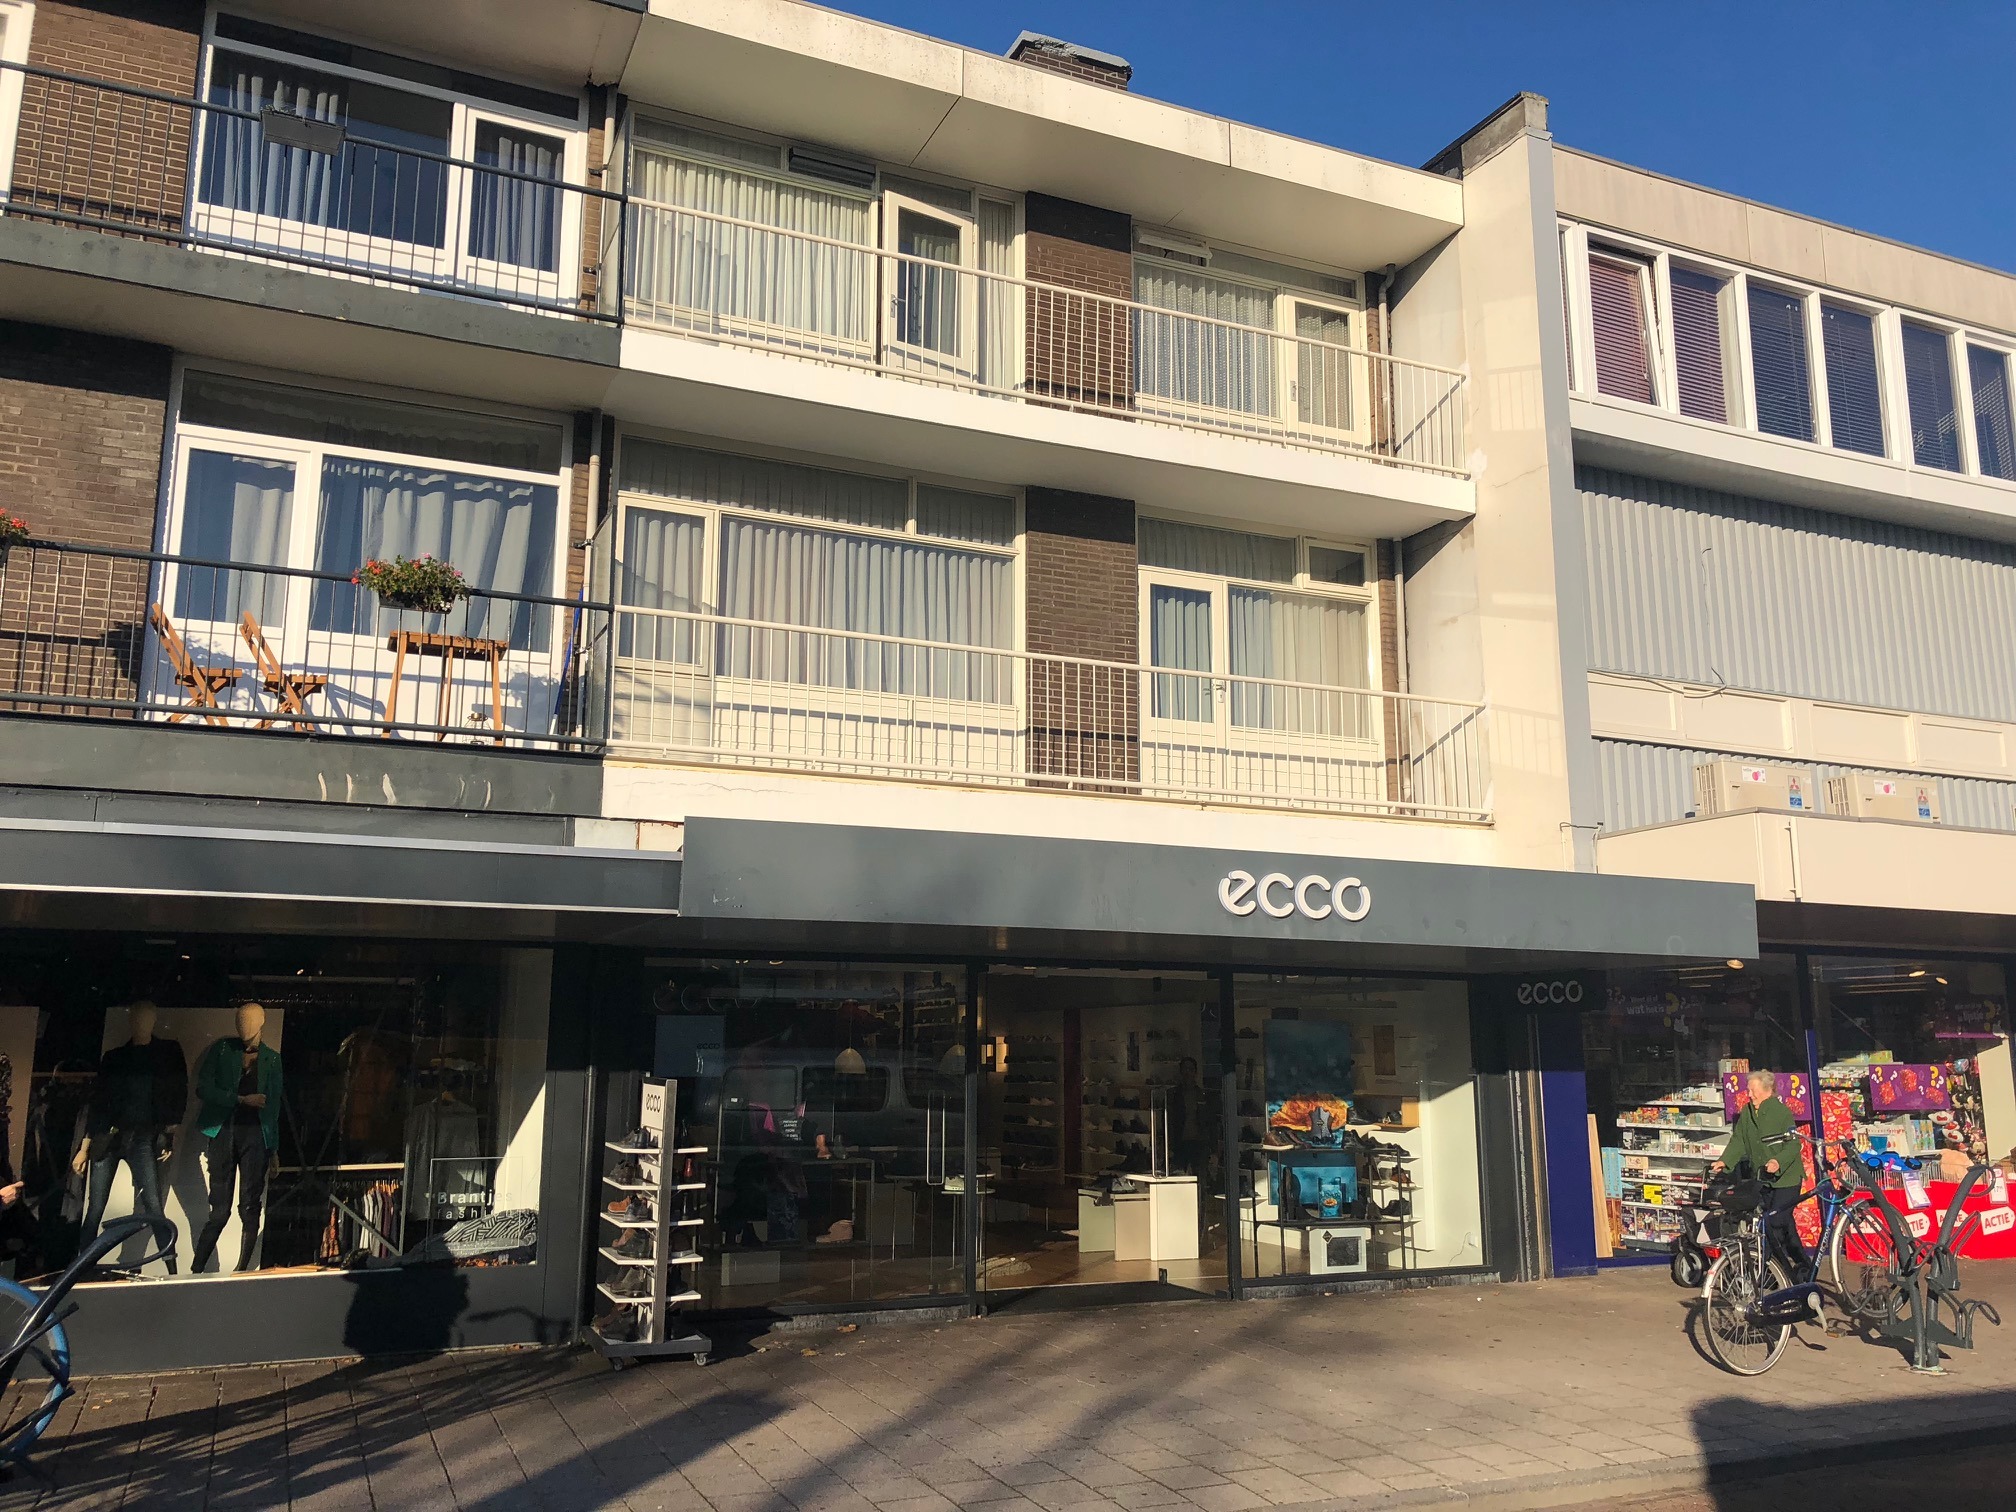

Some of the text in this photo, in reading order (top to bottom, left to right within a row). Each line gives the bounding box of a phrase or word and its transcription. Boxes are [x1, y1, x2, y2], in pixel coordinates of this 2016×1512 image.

[1217, 869, 1372, 922] ecco
[1517, 980, 1583, 1006] ecco
[437, 1189, 512, 1206] Brantjes
[1984, 1212, 2010, 1229] ACTIE
